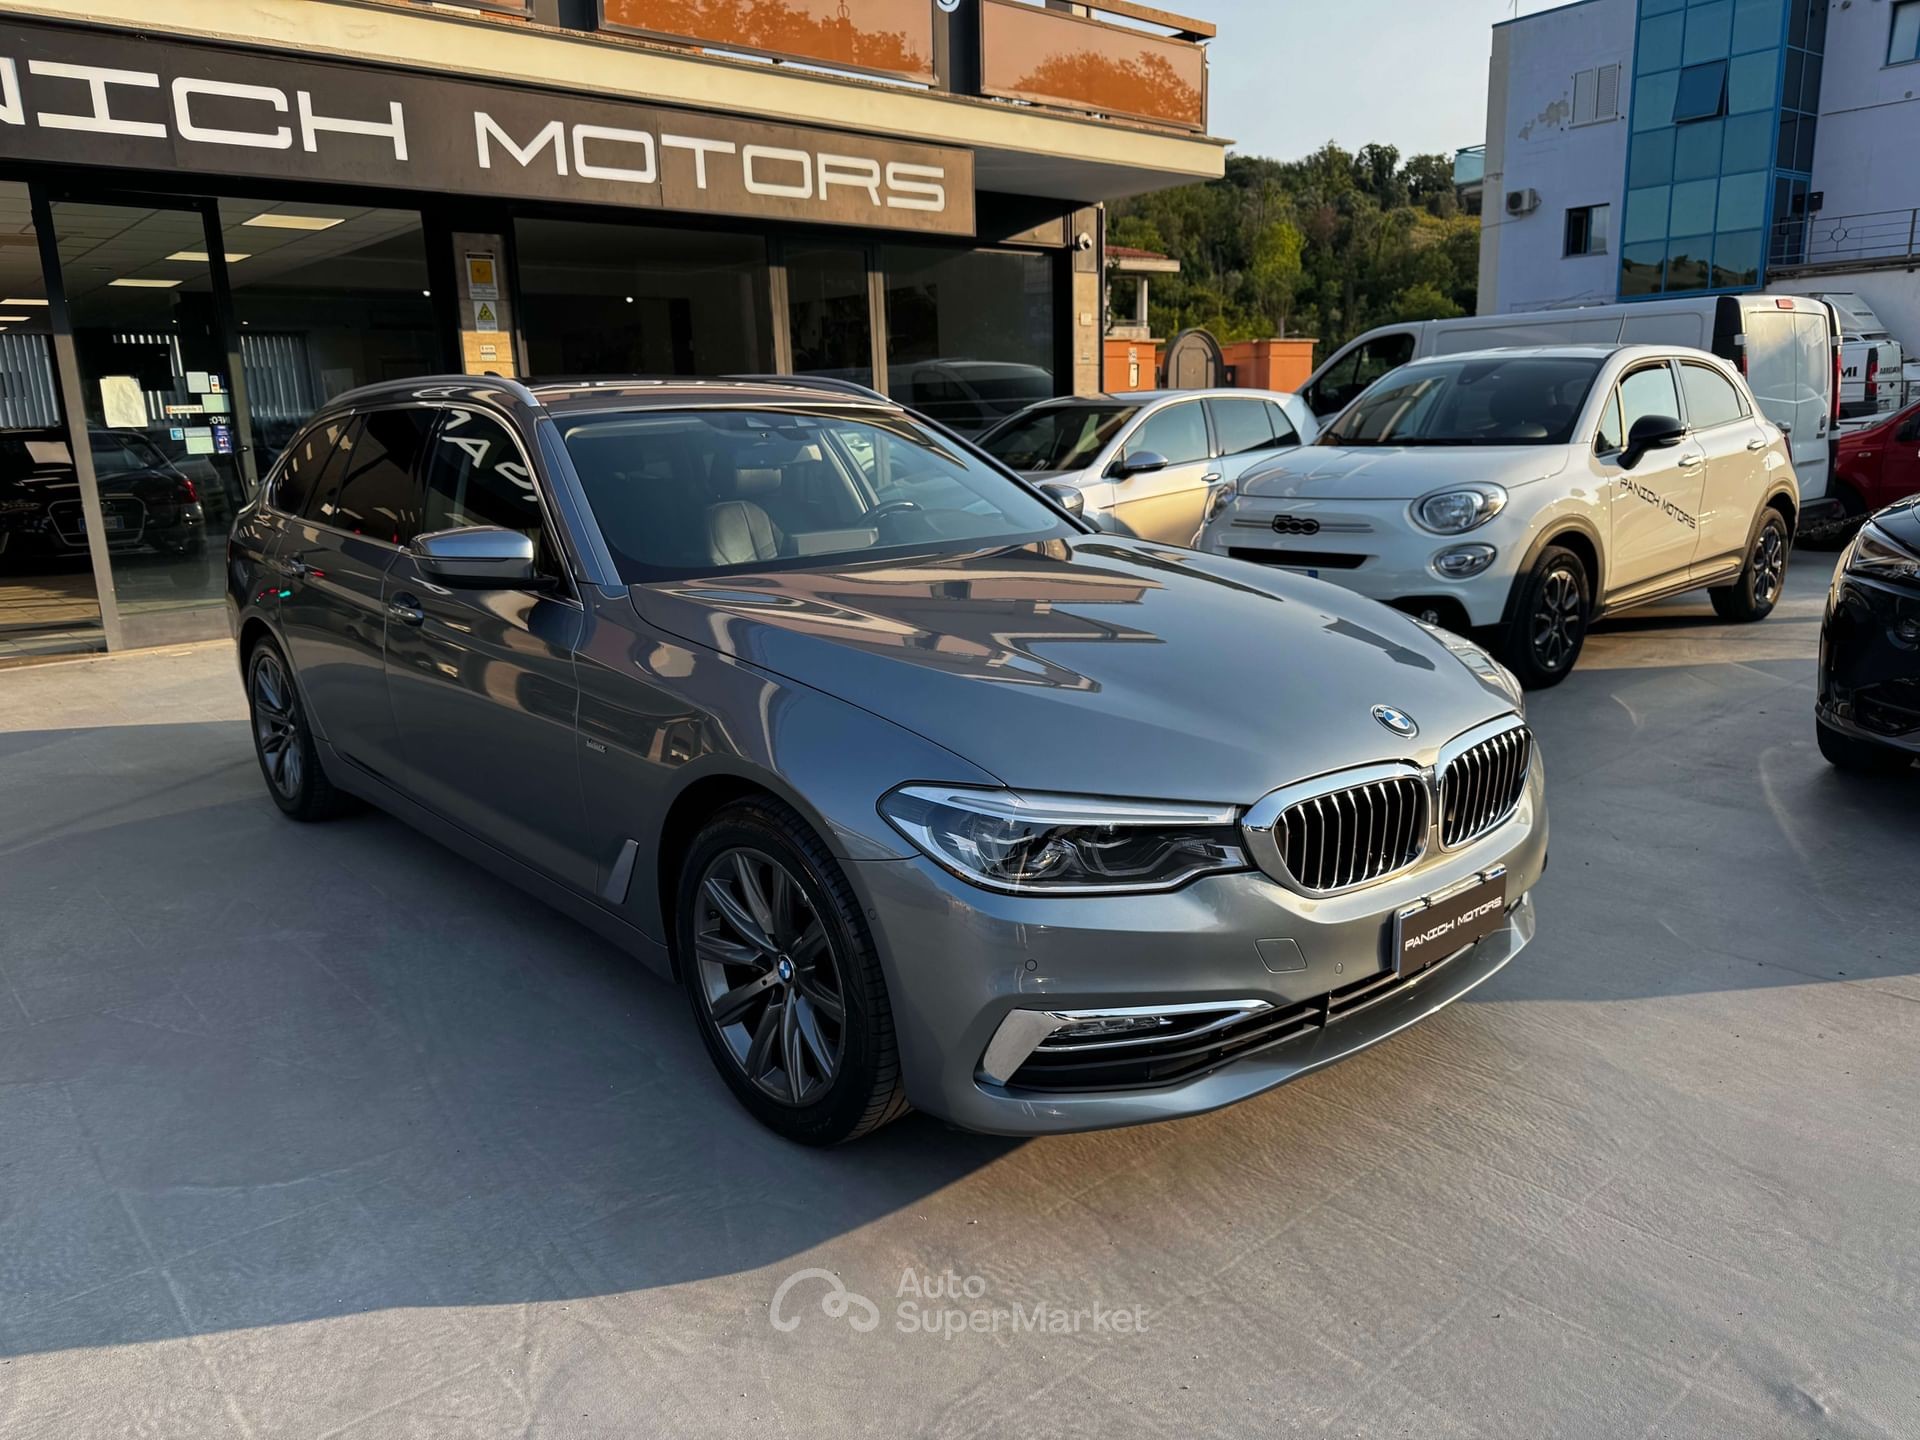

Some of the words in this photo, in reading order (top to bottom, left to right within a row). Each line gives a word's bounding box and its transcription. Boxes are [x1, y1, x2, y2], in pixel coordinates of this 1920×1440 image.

[0, 56, 409, 162] ICH
[473, 110, 945, 213] MOTORS
[1620, 477, 1660, 507] PANICH
[1662, 499, 1696, 529] MOTORS
[1404, 919, 1455, 951] PANICH
[1457, 896, 1503, 926] MOTORS
